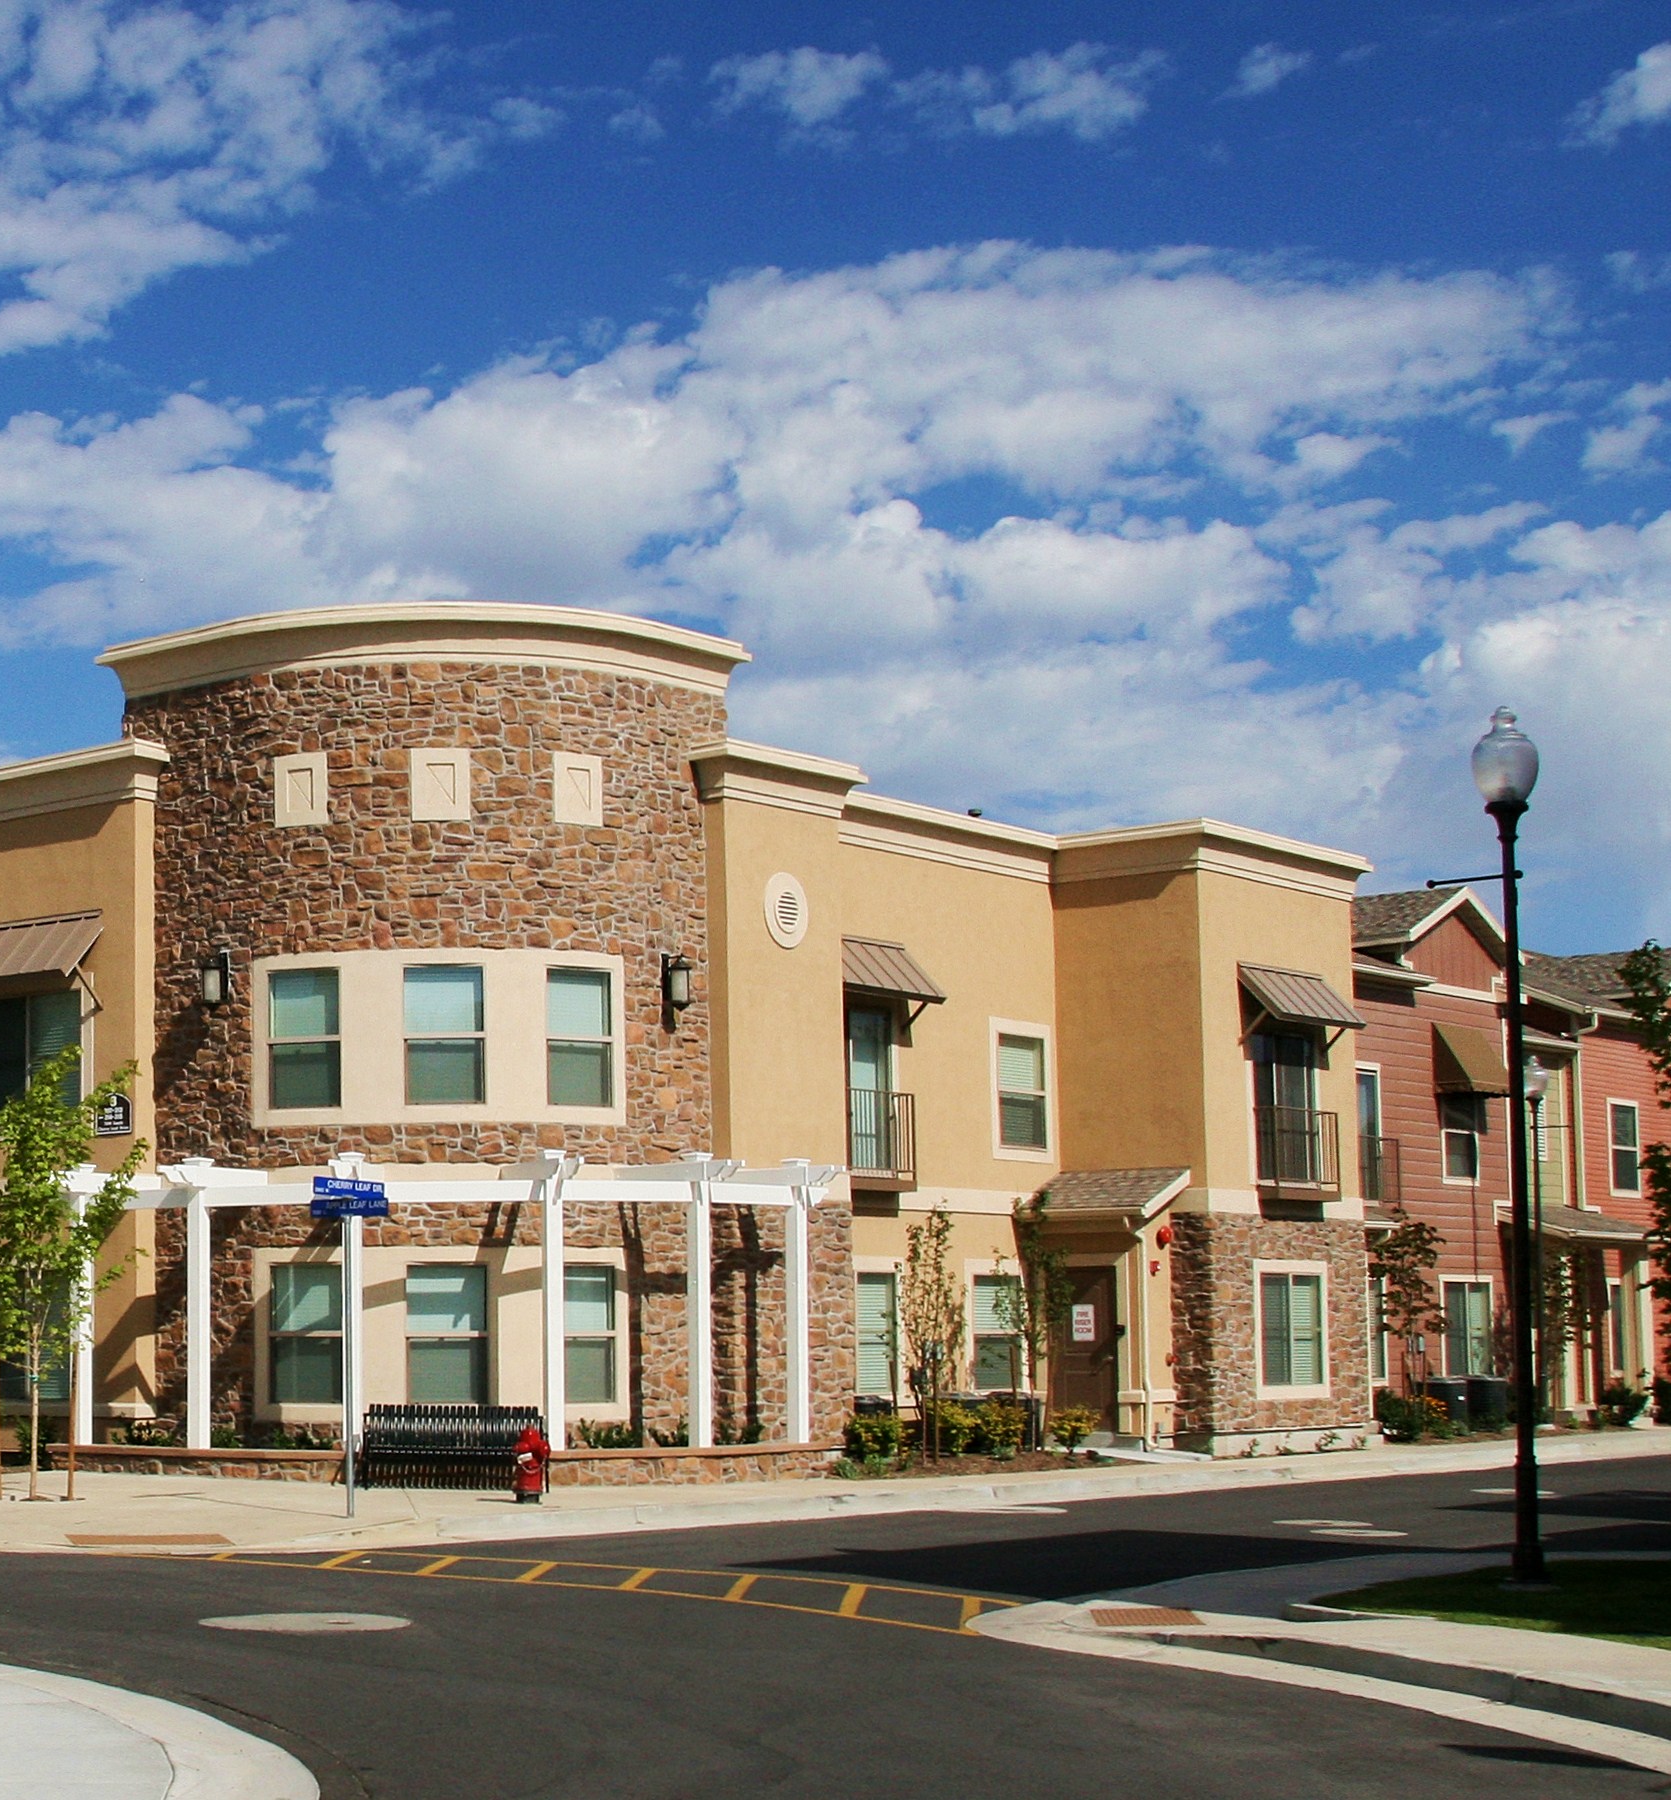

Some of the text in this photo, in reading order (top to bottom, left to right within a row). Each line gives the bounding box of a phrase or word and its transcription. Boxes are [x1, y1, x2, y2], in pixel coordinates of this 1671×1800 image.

[109, 1095, 118, 1107] 3
[327, 1179, 354, 1190] CHERRY
[355, 1182, 372, 1192] LEAF
[349, 1200, 367, 1209] LEAF
[369, 1199, 388, 1209] LANE
[1074, 1326, 1093, 1334] ROOM
